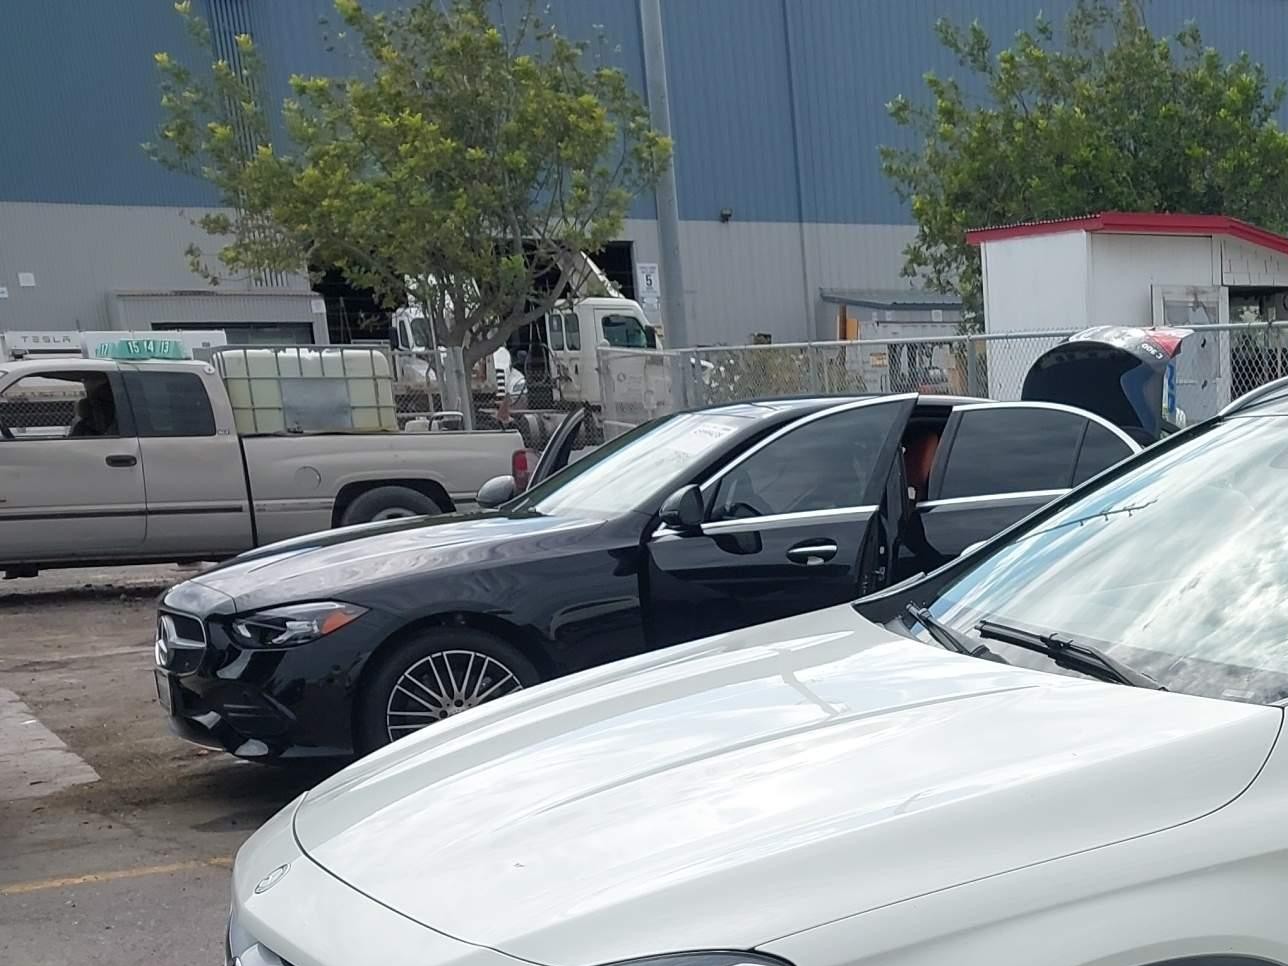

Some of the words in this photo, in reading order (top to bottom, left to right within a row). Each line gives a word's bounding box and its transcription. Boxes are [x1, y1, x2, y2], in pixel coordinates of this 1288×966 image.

[645, 274, 653, 287] 5
[21, 335, 71, 344] TESLA
[127, 341, 139, 353] 15
